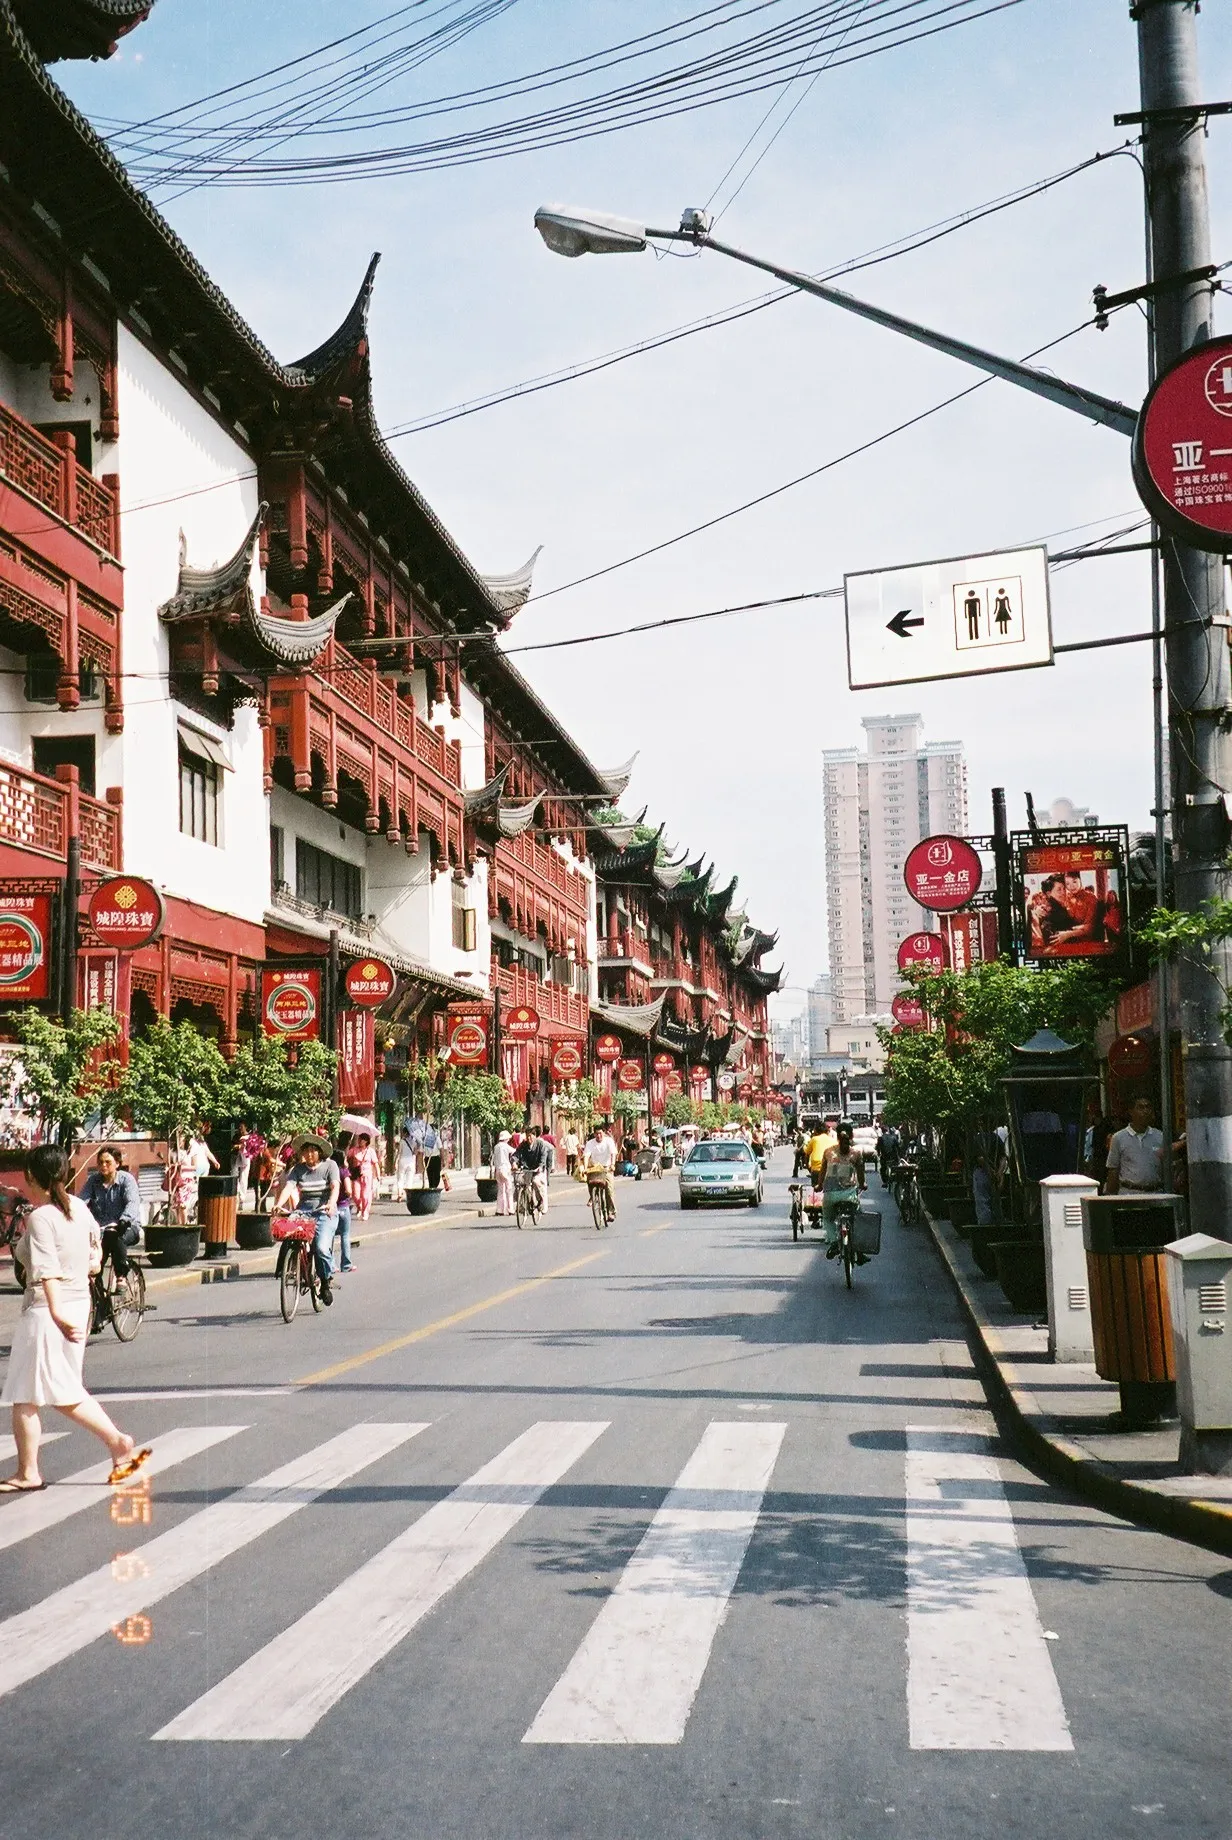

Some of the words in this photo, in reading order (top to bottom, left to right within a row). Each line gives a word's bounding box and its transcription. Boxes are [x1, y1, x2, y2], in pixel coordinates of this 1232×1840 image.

[1174, 472, 1229, 486] 上海著名商标
[1071, 849, 1114, 862] 亚一黄金
[916, 869, 970, 885] 亚一金店
[96, 911, 154, 926] 城隍珠寶
[0, 953, 44, 966] 器精品展
